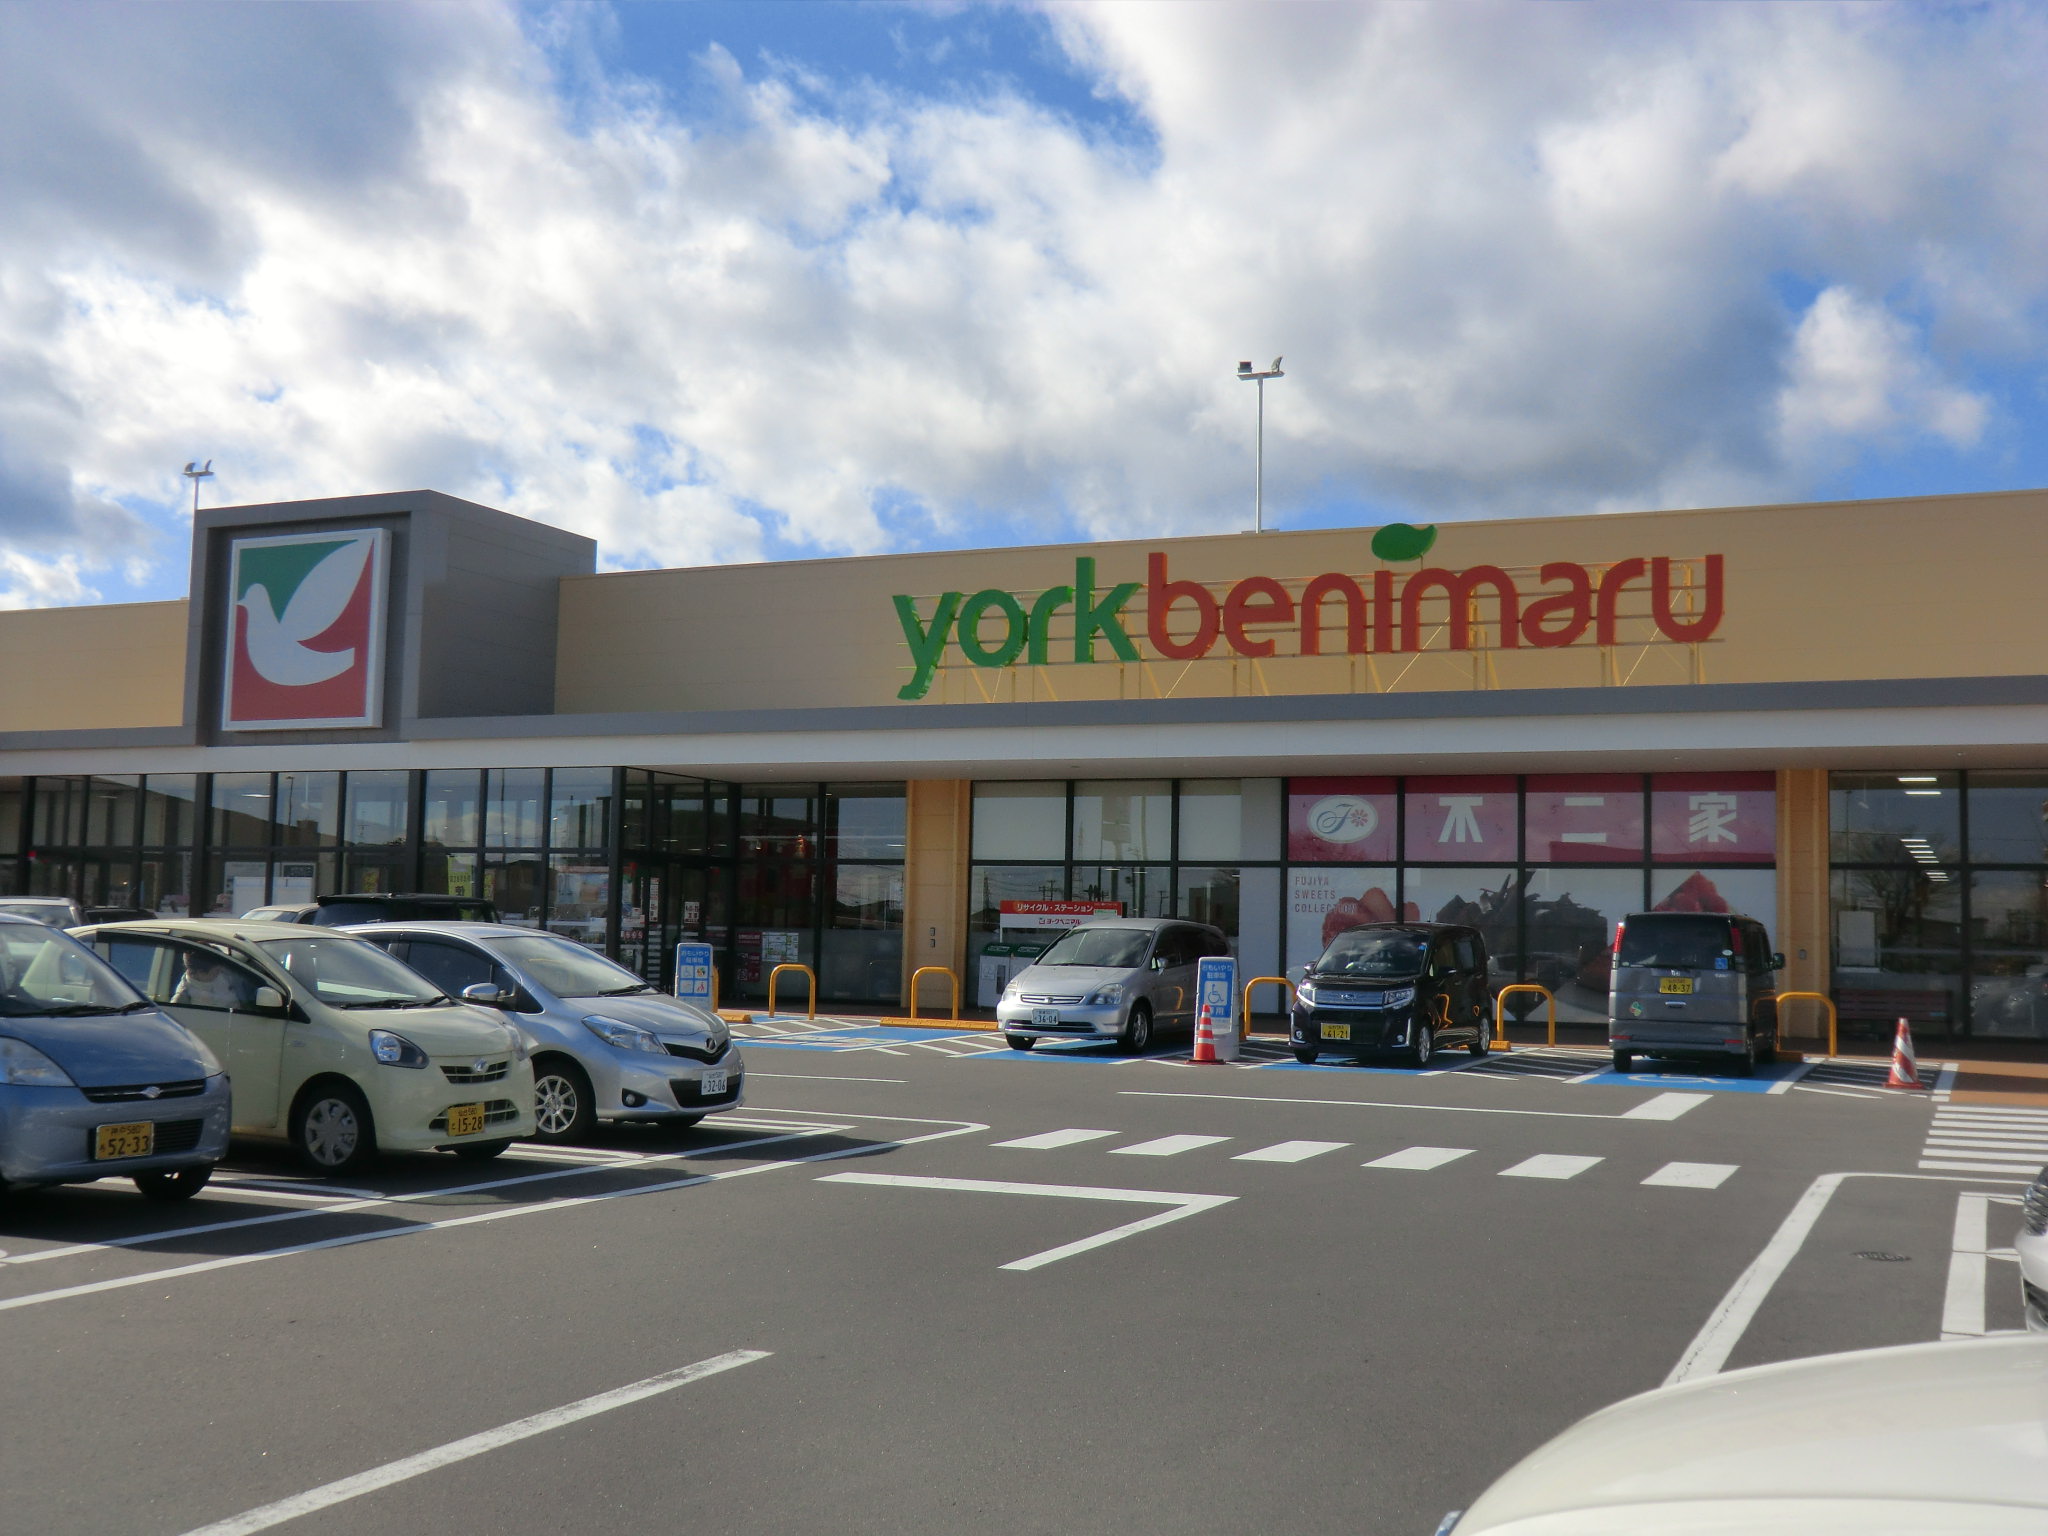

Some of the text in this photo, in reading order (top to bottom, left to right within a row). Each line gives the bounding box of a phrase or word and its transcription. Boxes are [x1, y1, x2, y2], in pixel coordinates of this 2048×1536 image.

[1437, 791, 1737, 844] 不二家
[1294, 876, 1330, 886] FUJIYA
[1294, 890, 1336, 900] SWEETS
[1017, 903, 1094, 913] リサイクル・ステーション
[1294, 903, 1357, 913] COLLECTION
[1201, 964, 1233, 972] おもいやり
[1327, 1030, 1348, 1039] 61-21
[458, 1116, 483, 1133] 15-28
[108, 1135, 149, 1156] 52-33
